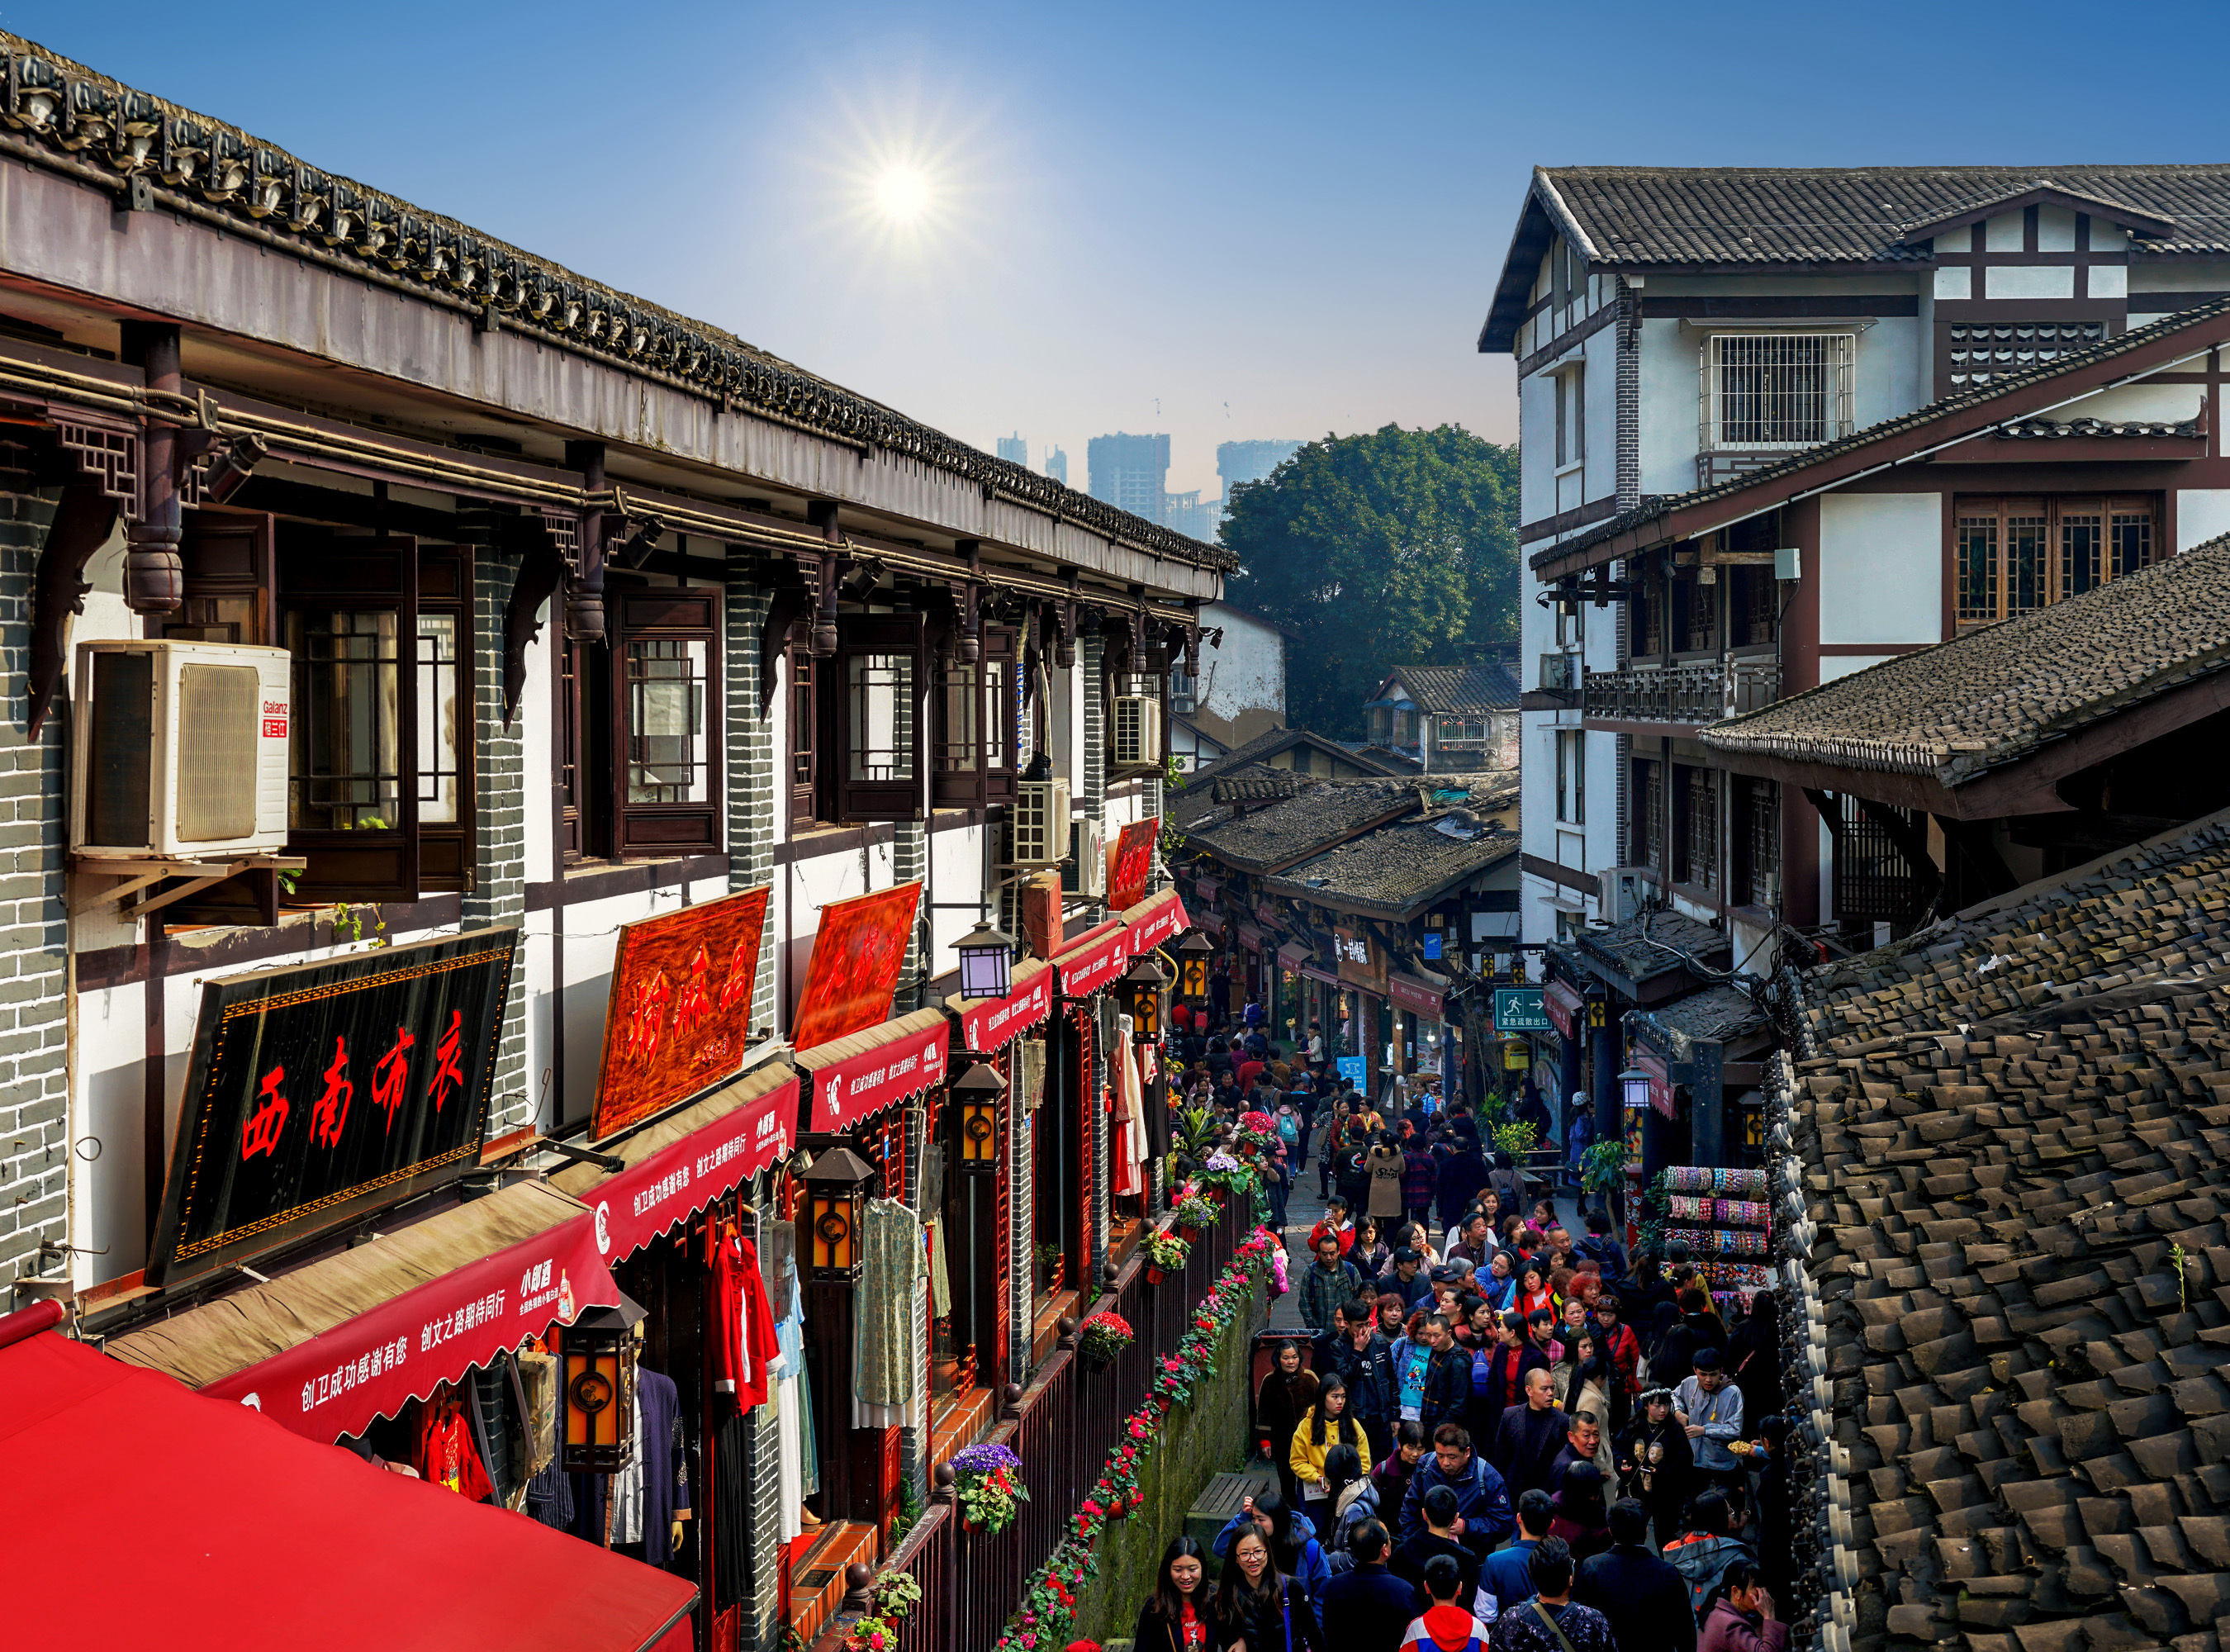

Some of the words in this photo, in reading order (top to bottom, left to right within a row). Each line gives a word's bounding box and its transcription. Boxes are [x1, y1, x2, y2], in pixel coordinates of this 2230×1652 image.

[263, 700, 287, 714] Galanz
[264, 721, 286, 736] 格兰仕
[1502, 1018, 1548, 1026] 紧急疏散出口
[241, 1009, 464, 1162] 西南布衣
[756, 1110, 776, 1139] 小郎酒
[633, 1165, 690, 1218] 创卫成功感谢有您
[696, 1132, 747, 1179] 创文之路期待同行
[520, 1258, 553, 1298] 小郎酒
[301, 1335, 408, 1412] 创卫成功感谢有您
[420, 1289, 505, 1352] 创文之路期待同行
